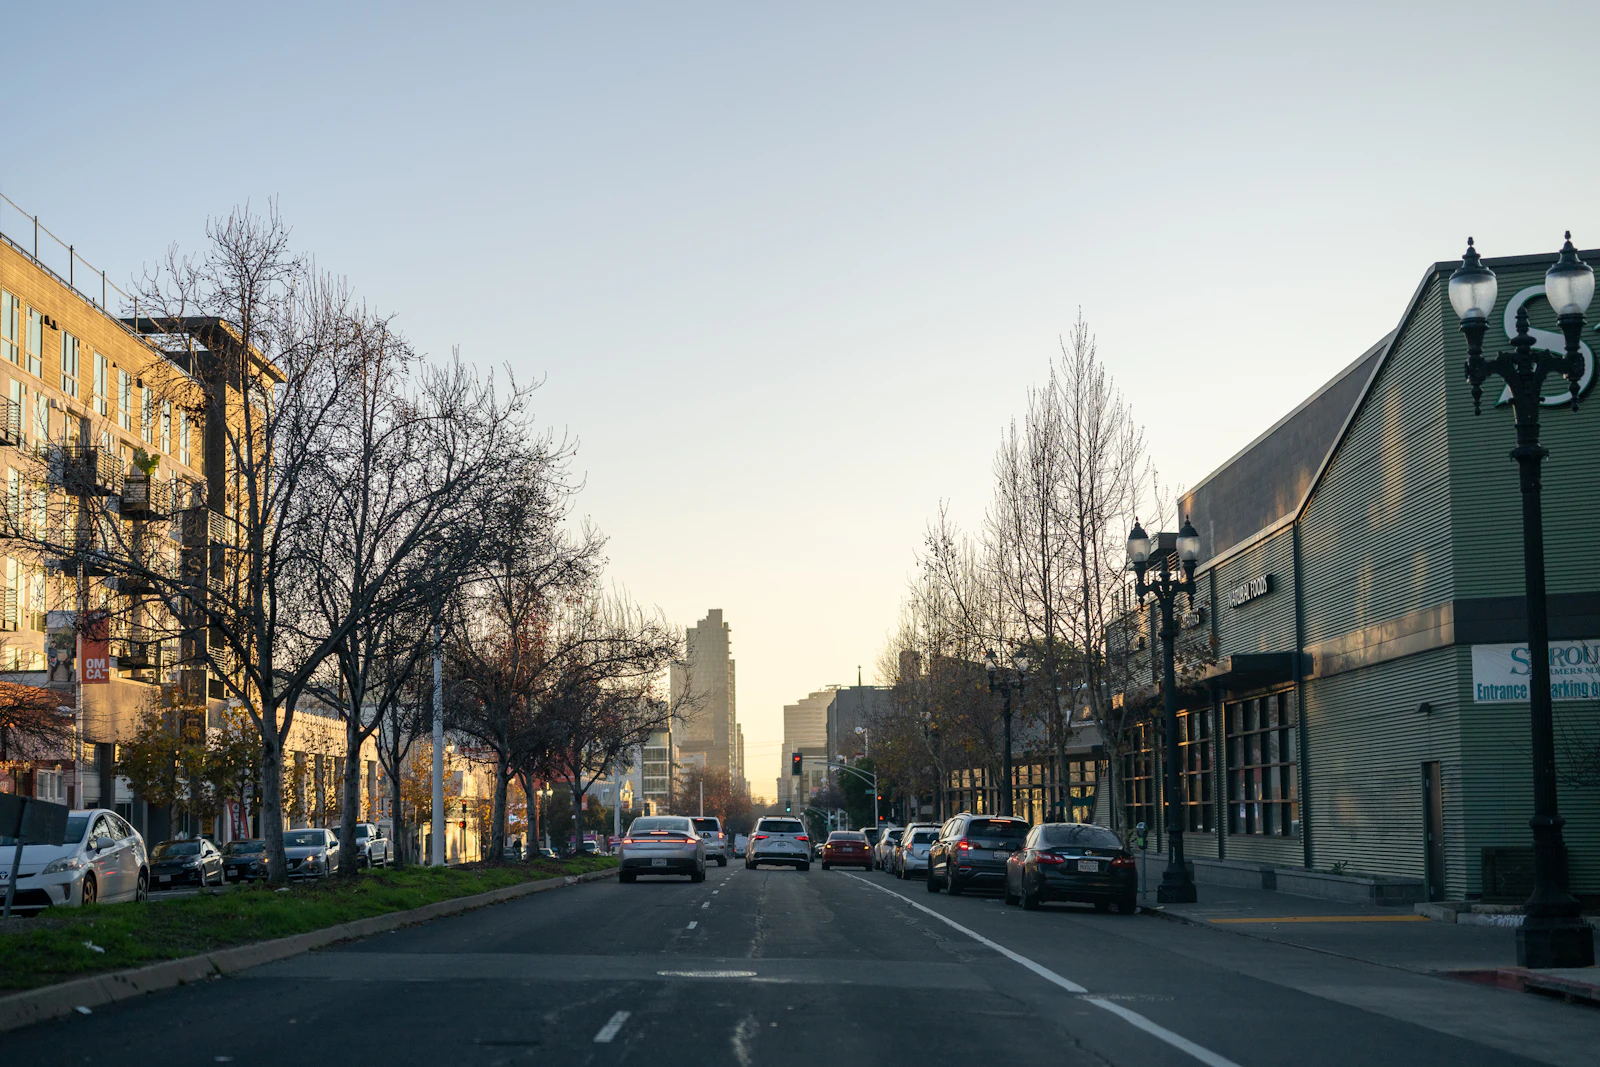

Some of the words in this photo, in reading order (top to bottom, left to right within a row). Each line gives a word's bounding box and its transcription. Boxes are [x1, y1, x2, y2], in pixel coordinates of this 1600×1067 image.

[1496, 284, 1600, 407] S
[1227, 582, 1250, 609] NATURAL
[1250, 575, 1267, 599] FOODS
[1510, 645, 1600, 675] SROU
[1549, 667, 1582, 675] RMERS
[1477, 683, 1527, 700] Entrance
[1551, 680, 1588, 698] arking
